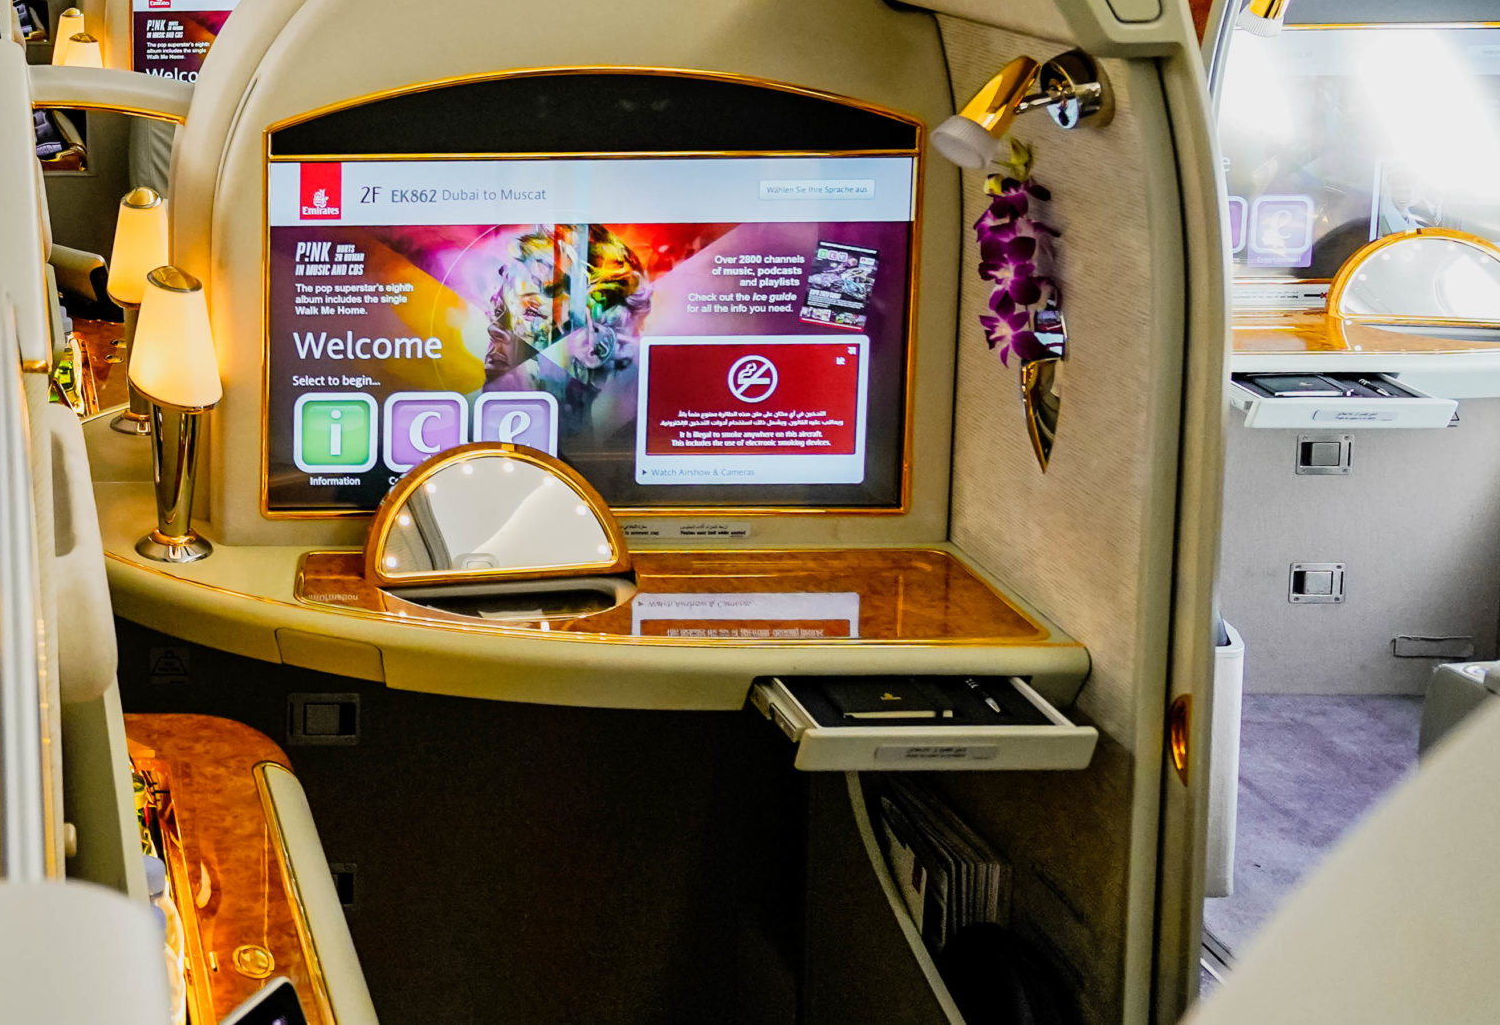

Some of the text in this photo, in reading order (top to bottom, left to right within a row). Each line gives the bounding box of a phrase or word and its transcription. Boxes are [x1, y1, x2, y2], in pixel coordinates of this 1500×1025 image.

[147, 20, 166, 31] P!NK
[360, 187, 546, 204] 2F EK862 Dubai to Muscat
[825, 186, 853, 195] Sprache
[302, 207, 339, 215] Emirates
[295, 242, 331, 262] P!NK
[714, 255, 737, 263] Over
[764, 255, 805, 263] channels
[712, 267, 802, 277] of music, podcasts
[740, 278, 800, 288] and playlists
[295, 283, 413, 295] The pop superstar's eighth
[295, 294, 407, 305] album includes the single
[688, 293, 716, 301] Check
[736, 293, 750, 301] the
[770, 293, 797, 303] guide
[295, 306, 368, 315] Walk Me Home.
[687, 304, 699, 312] for
[701, 304, 711, 312] all
[731, 304, 748, 312] info
[750, 306, 766, 315] you
[769, 304, 793, 312] need.
[293, 331, 442, 359] Welcome
[293, 375, 380, 388] Select to begin...
[330, 410, 531, 455] i c e
[310, 477, 360, 485] Information
